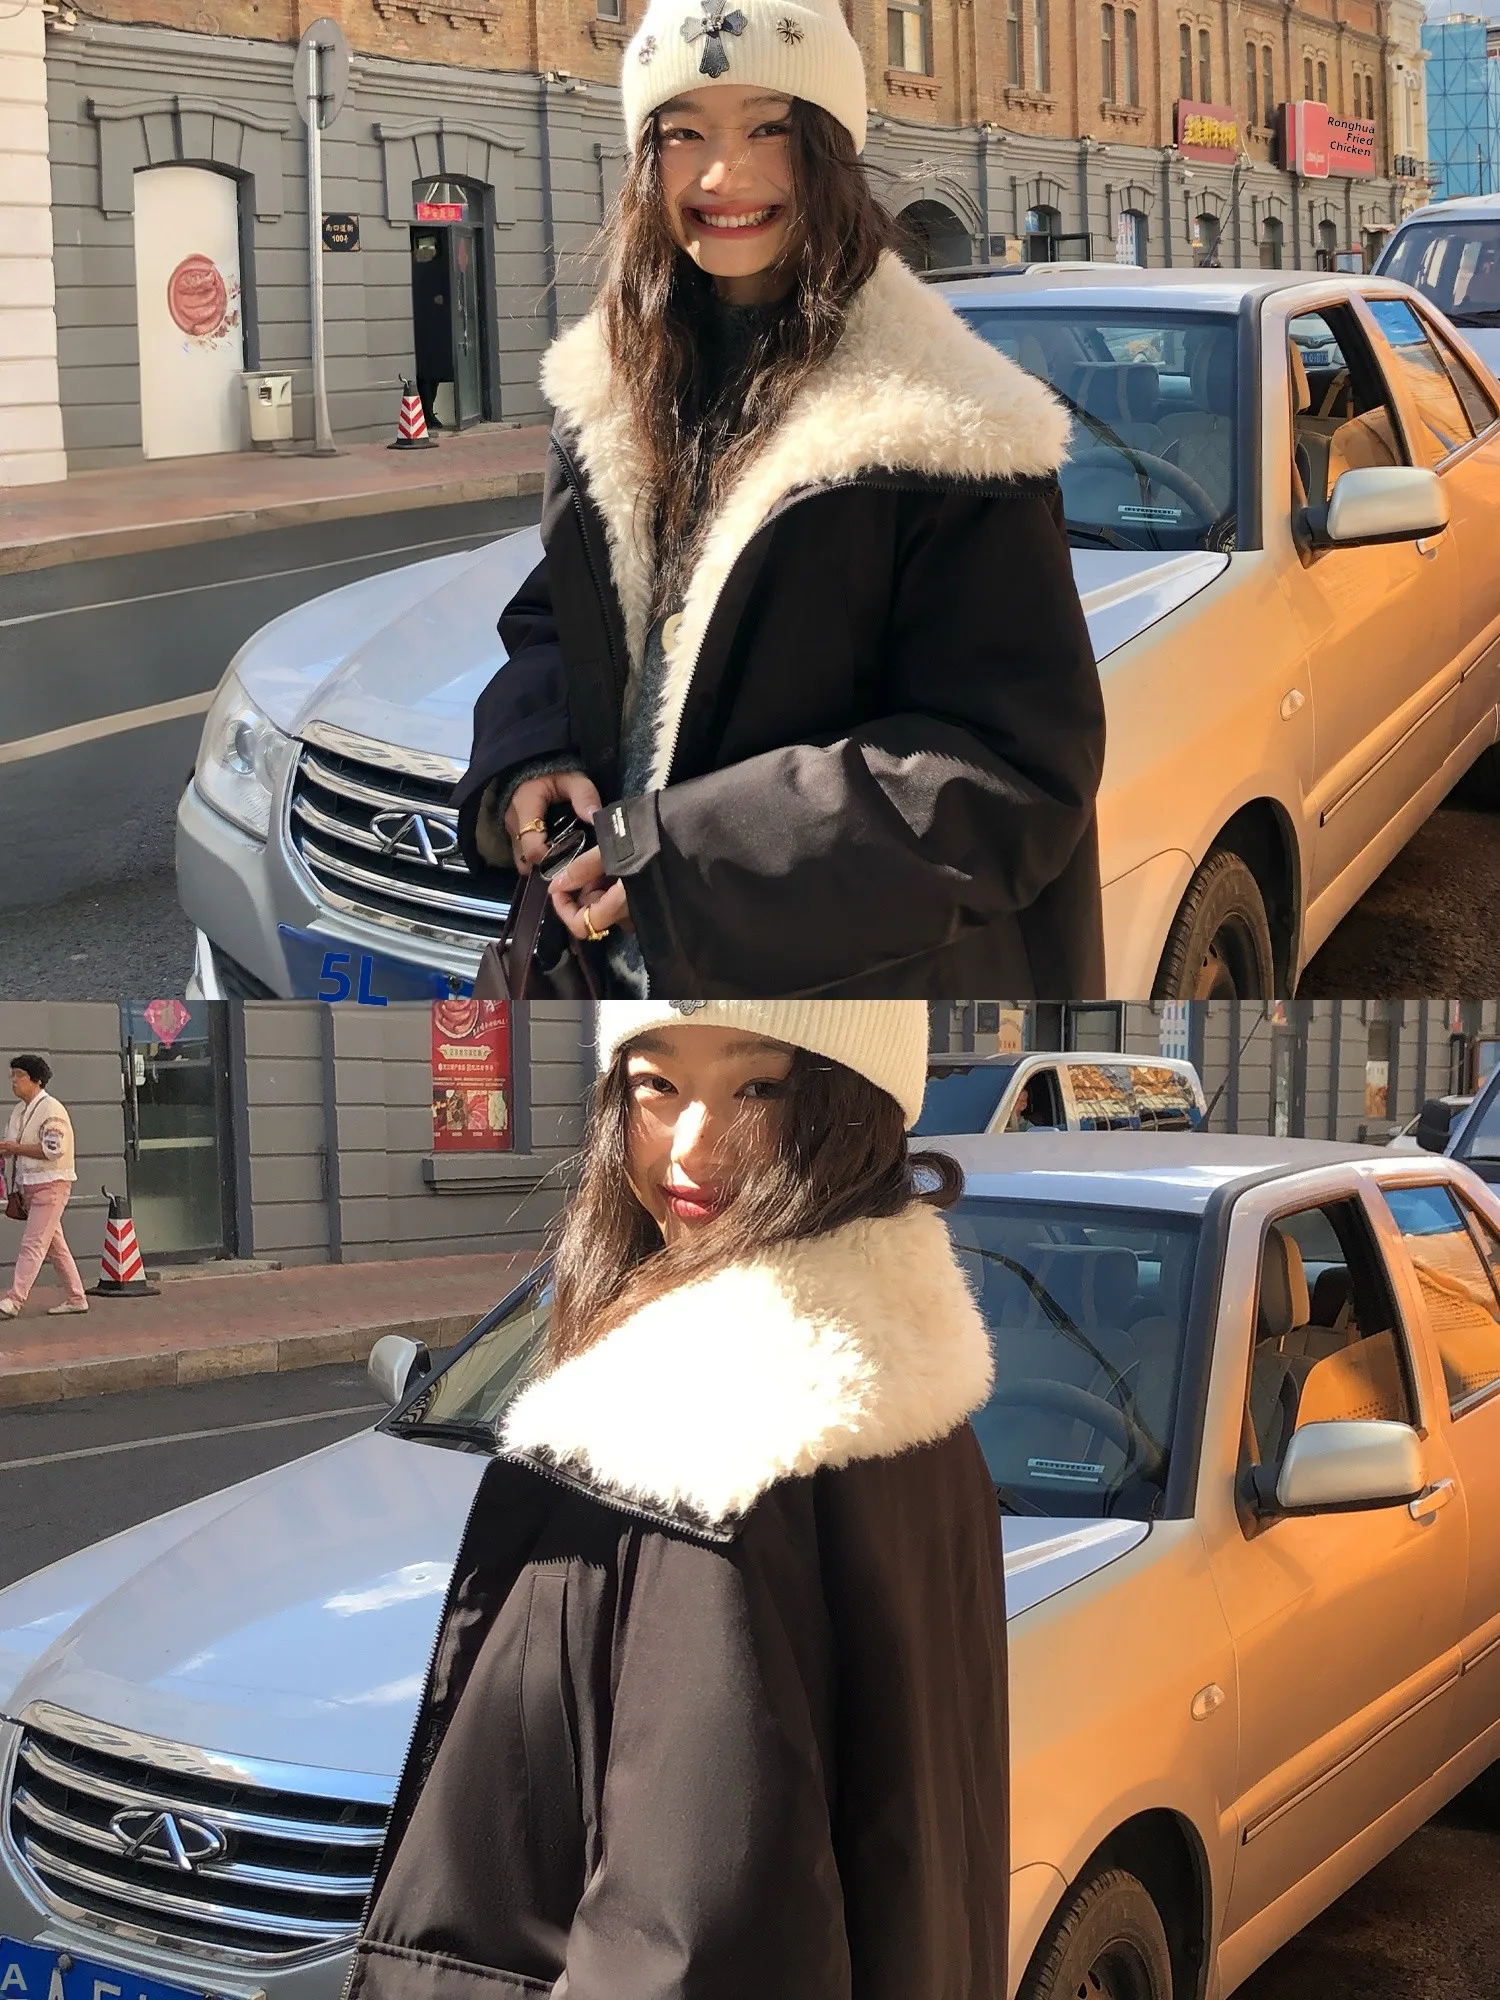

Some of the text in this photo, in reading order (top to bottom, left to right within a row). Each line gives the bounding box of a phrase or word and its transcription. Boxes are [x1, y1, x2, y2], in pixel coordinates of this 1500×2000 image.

[1327, 116, 1375, 134] Ronghua
[1346, 132, 1374, 146] Fried
[1330, 140, 1371, 157] Chicken
[318, 951, 389, 1007] 5L
